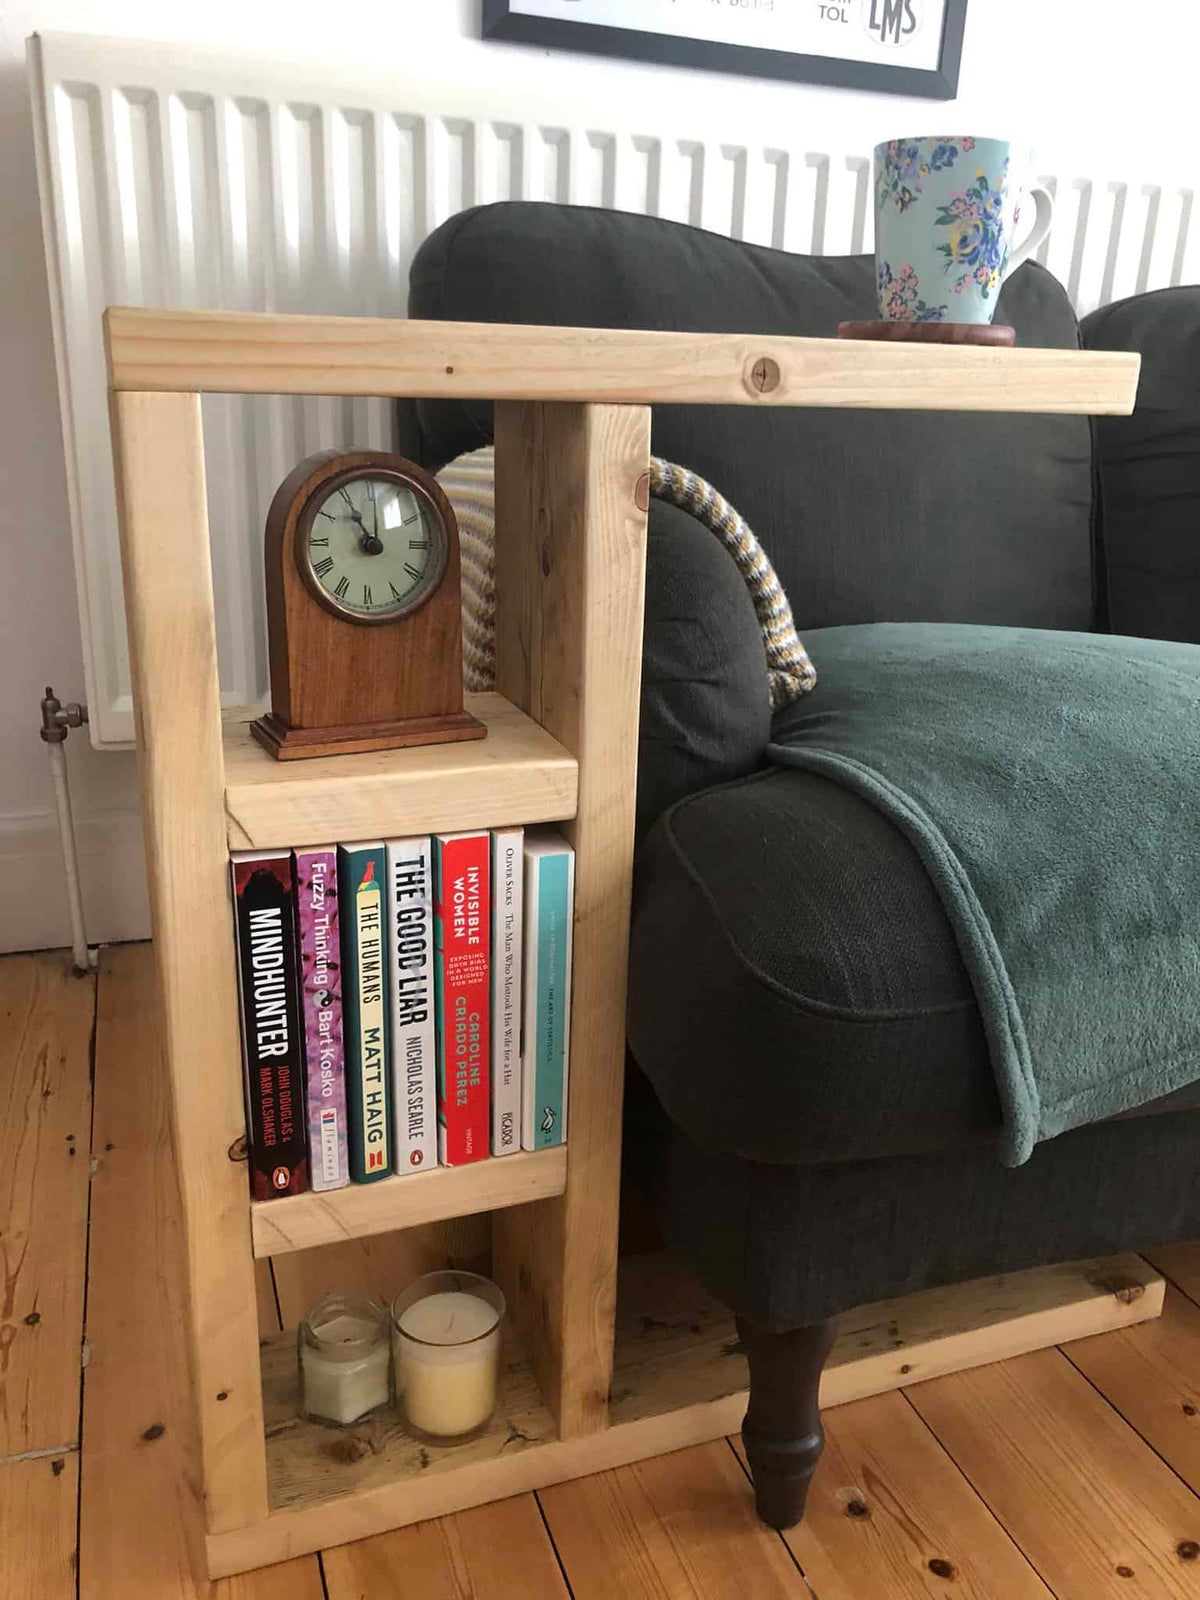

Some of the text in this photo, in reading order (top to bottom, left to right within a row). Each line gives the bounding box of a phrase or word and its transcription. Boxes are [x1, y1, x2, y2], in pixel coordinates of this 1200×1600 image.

[819, 5, 849, 23] TOL
[869, 0, 917, 43] LMS
[505, 848, 515, 906] OLIVER SACKS
[310, 863, 330, 985] Fuzzy Thinking
[453, 877, 465, 938] WOMEN
[467, 866, 480, 945] INVISIBLE
[505, 913, 514, 930] The
[360, 902, 381, 1004] THE HUMANS
[395, 855, 428, 1027] THE GOOD LIAR
[450, 952, 485, 963] EXPOSING
[504, 953, 514, 975] Who
[505, 931, 514, 952] Man
[249, 908, 289, 1059] MINDHUNTER
[504, 976, 513, 1010] Mistook
[503, 1028, 513, 1048] Wife
[504, 1012, 513, 1028] His
[318, 1011, 336, 1098] Bart Kosko
[455, 996, 467, 1106] CRIADO PEREZ
[469, 1012, 480, 1086] CAROLINE
[503, 1049, 512, 1061] for
[278, 1065, 290, 1088] JOHN
[364, 1027, 383, 1144] MATT HAIG
[406, 1036, 424, 1140] NICHOLAS SEARLE
[503, 1069, 512, 1085] Hat
[259, 1067, 276, 1147] MARK OLSHAKER
[280, 1089, 293, 1135] DOUGLAS
[502, 1112, 513, 1147] PICADOR
